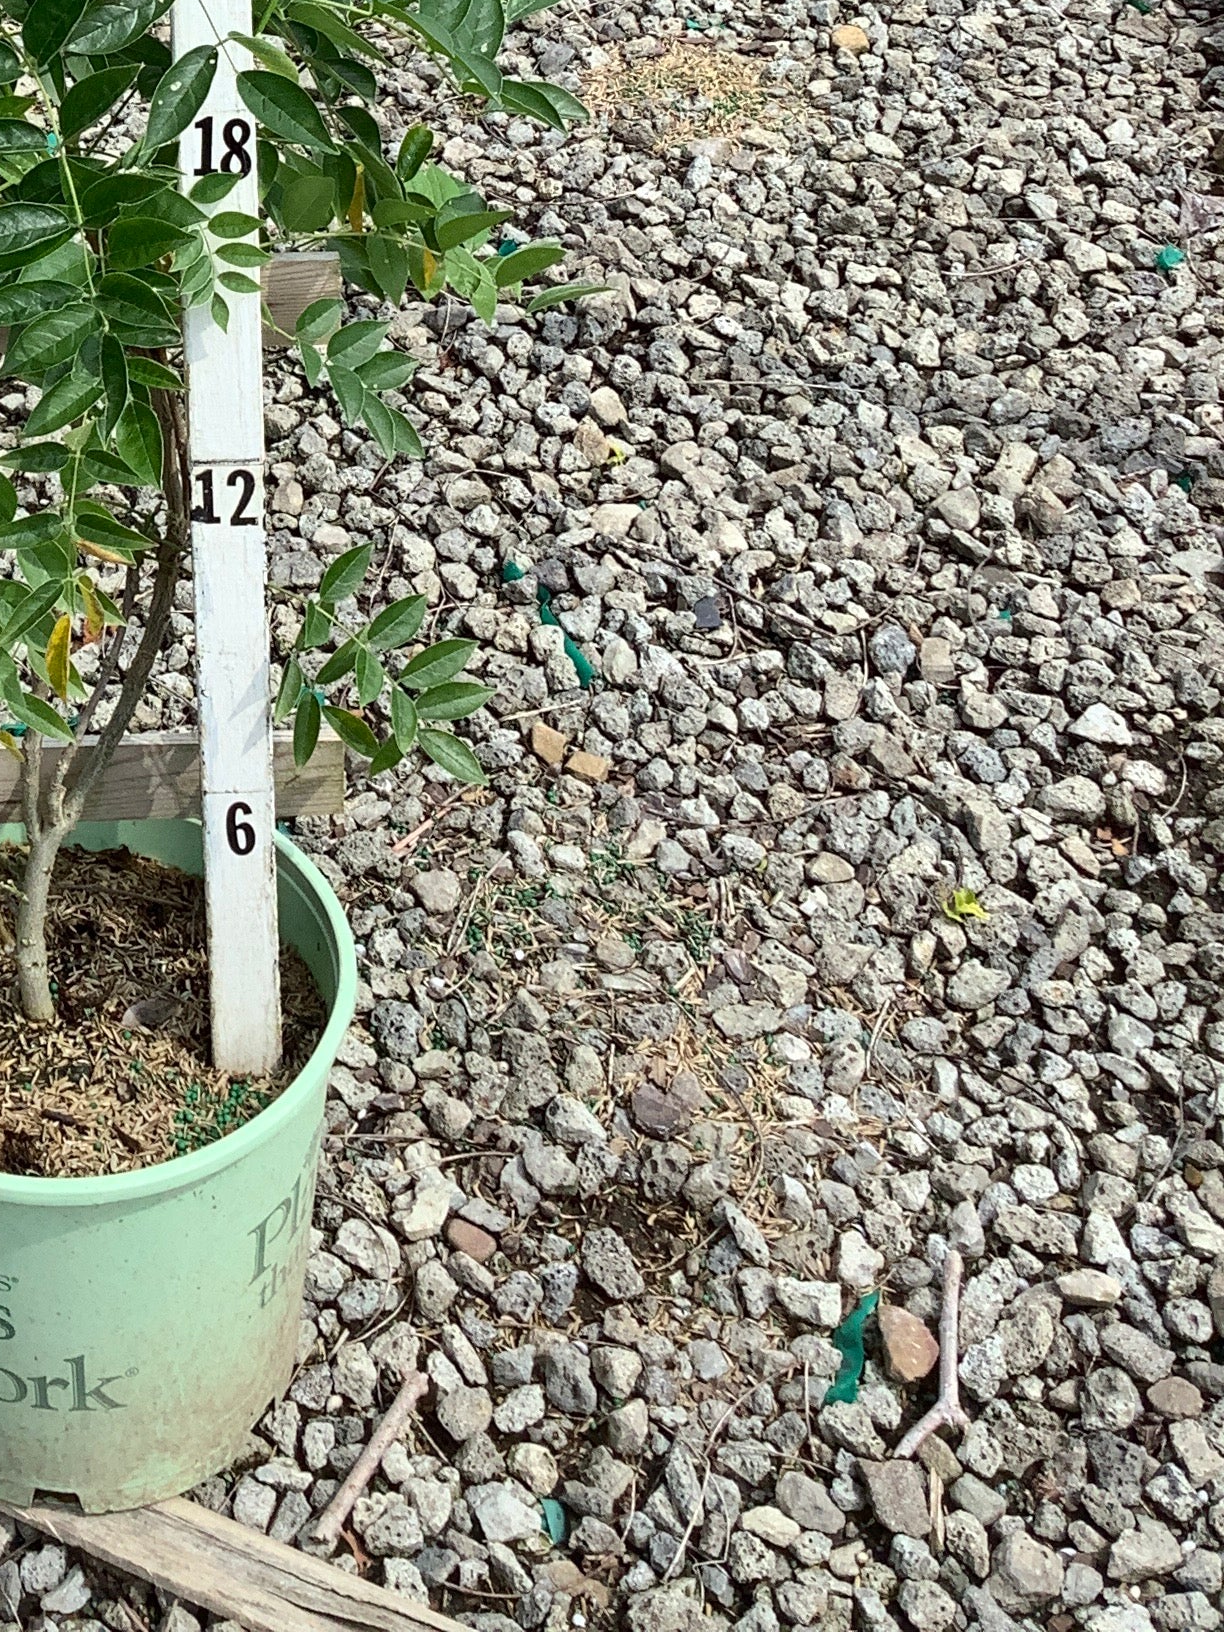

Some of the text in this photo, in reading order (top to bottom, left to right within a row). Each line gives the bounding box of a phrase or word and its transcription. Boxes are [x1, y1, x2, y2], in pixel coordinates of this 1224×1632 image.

[193, 115, 253, 180] 18
[192, 468, 260, 527] 12
[225, 801, 257, 857] 6
